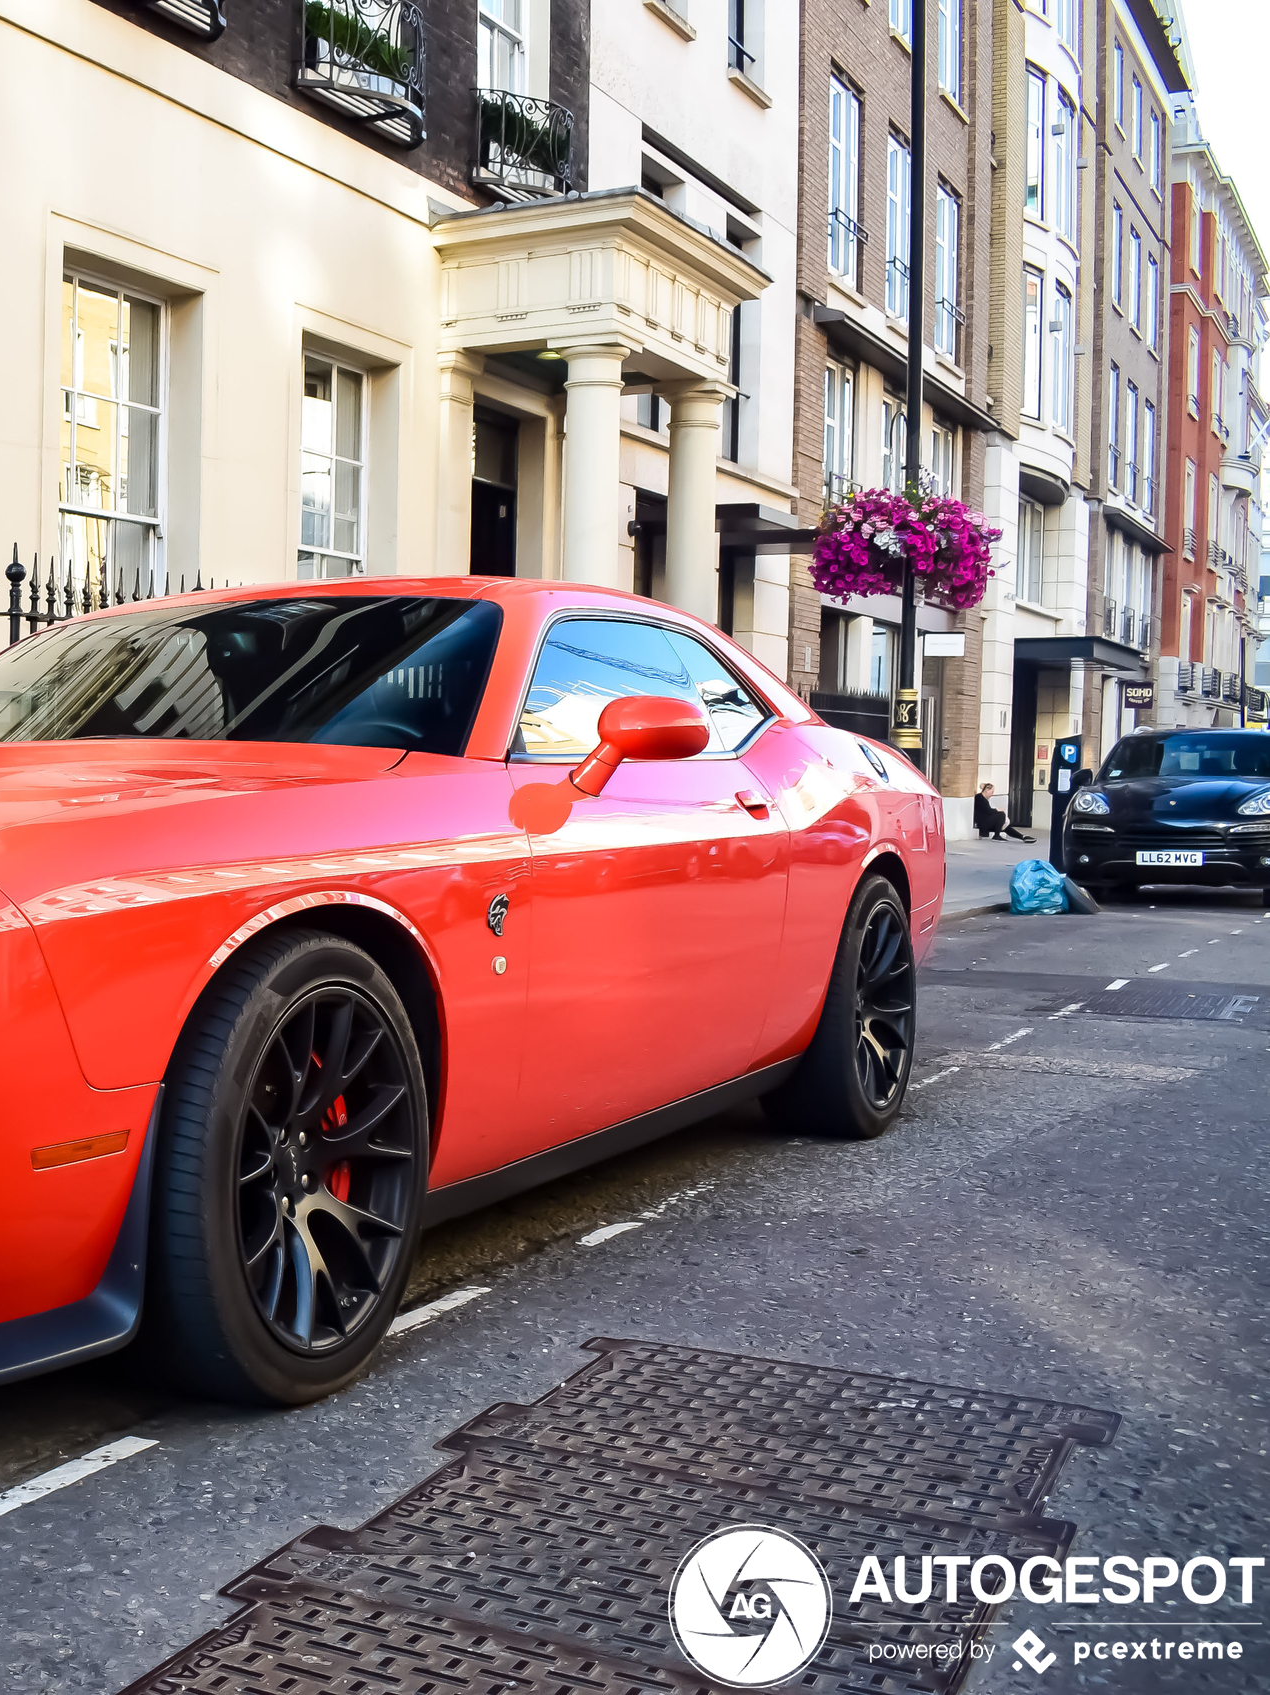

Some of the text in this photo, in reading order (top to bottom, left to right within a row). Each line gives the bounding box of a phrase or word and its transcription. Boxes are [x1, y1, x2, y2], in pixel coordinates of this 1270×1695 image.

[1126, 687, 1152, 697] SOHO
[1064, 745, 1075, 760] P
[1141, 853, 1197, 863] LL62 MVG
